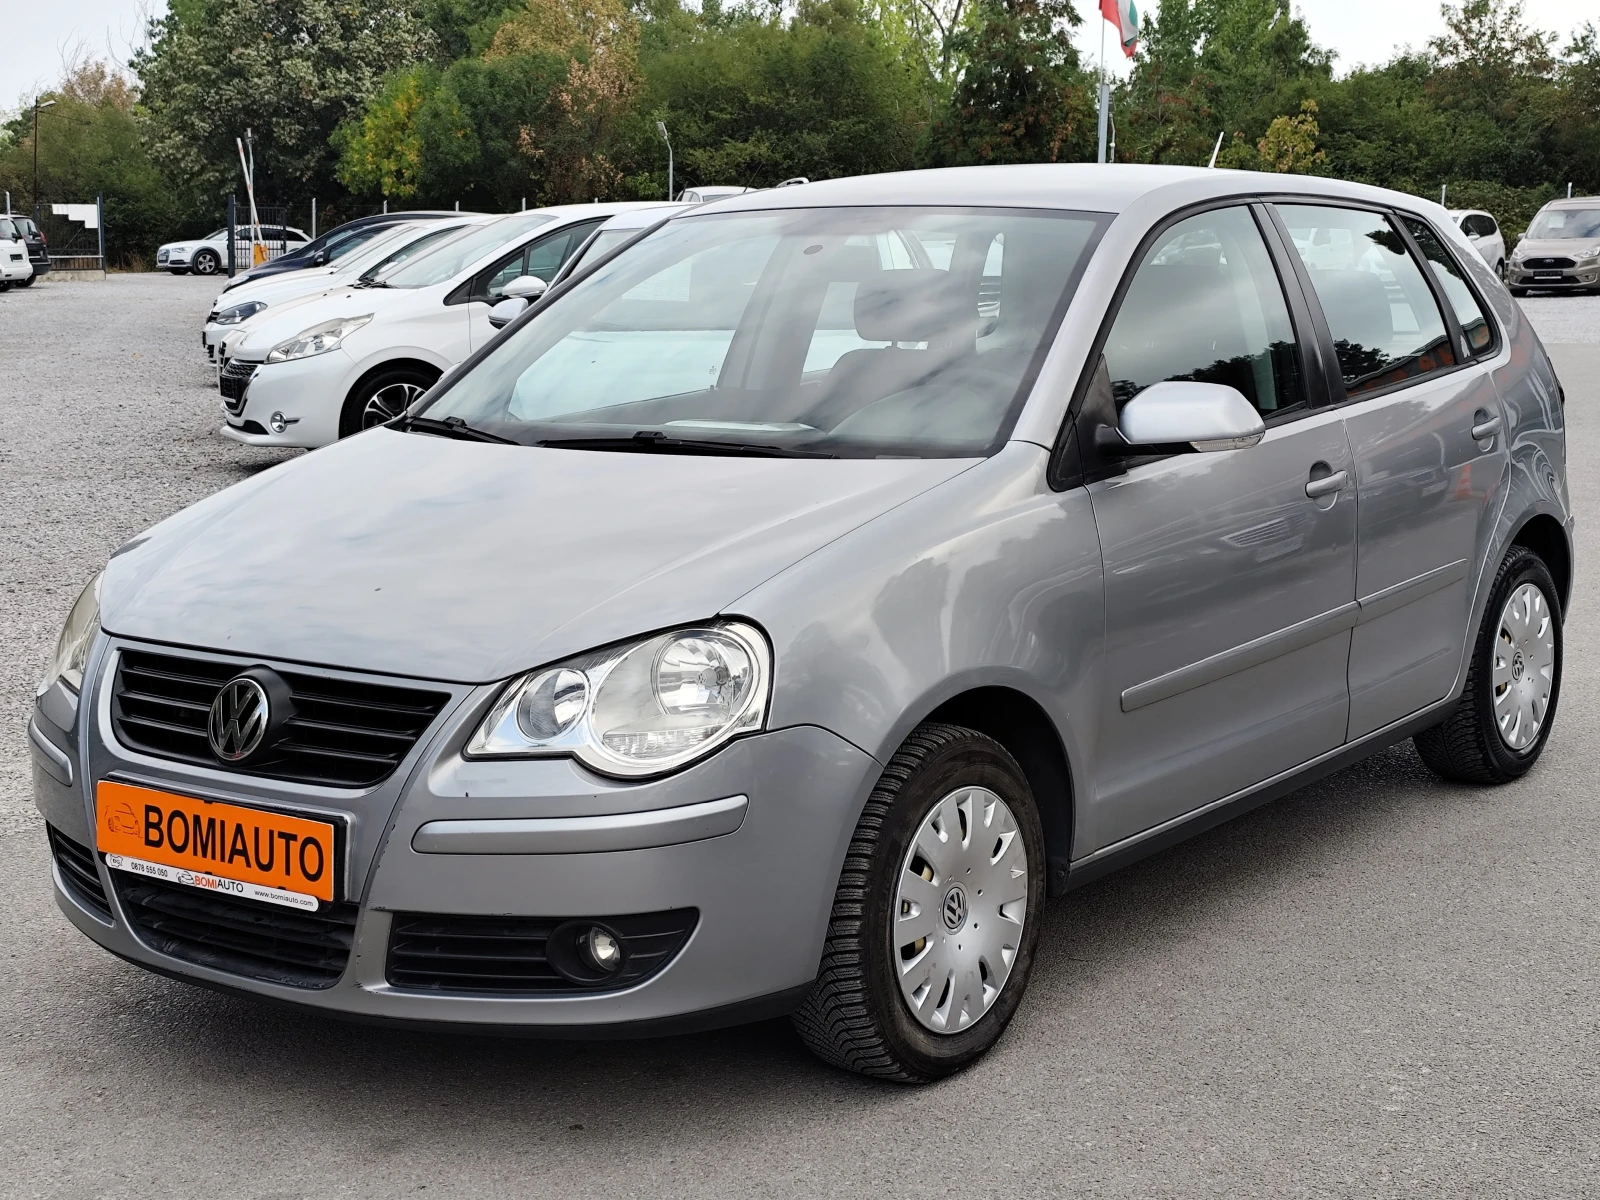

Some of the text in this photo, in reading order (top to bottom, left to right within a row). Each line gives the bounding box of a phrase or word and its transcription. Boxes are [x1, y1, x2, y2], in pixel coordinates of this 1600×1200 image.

[209, 679, 268, 760] VW
[144, 804, 324, 882] BOMIAUTO
[131, 861, 168, 878] 0878 555 050
[194, 875, 244, 893] BOMIAUTO
[254, 889, 314, 907] www.bomiauto.com
